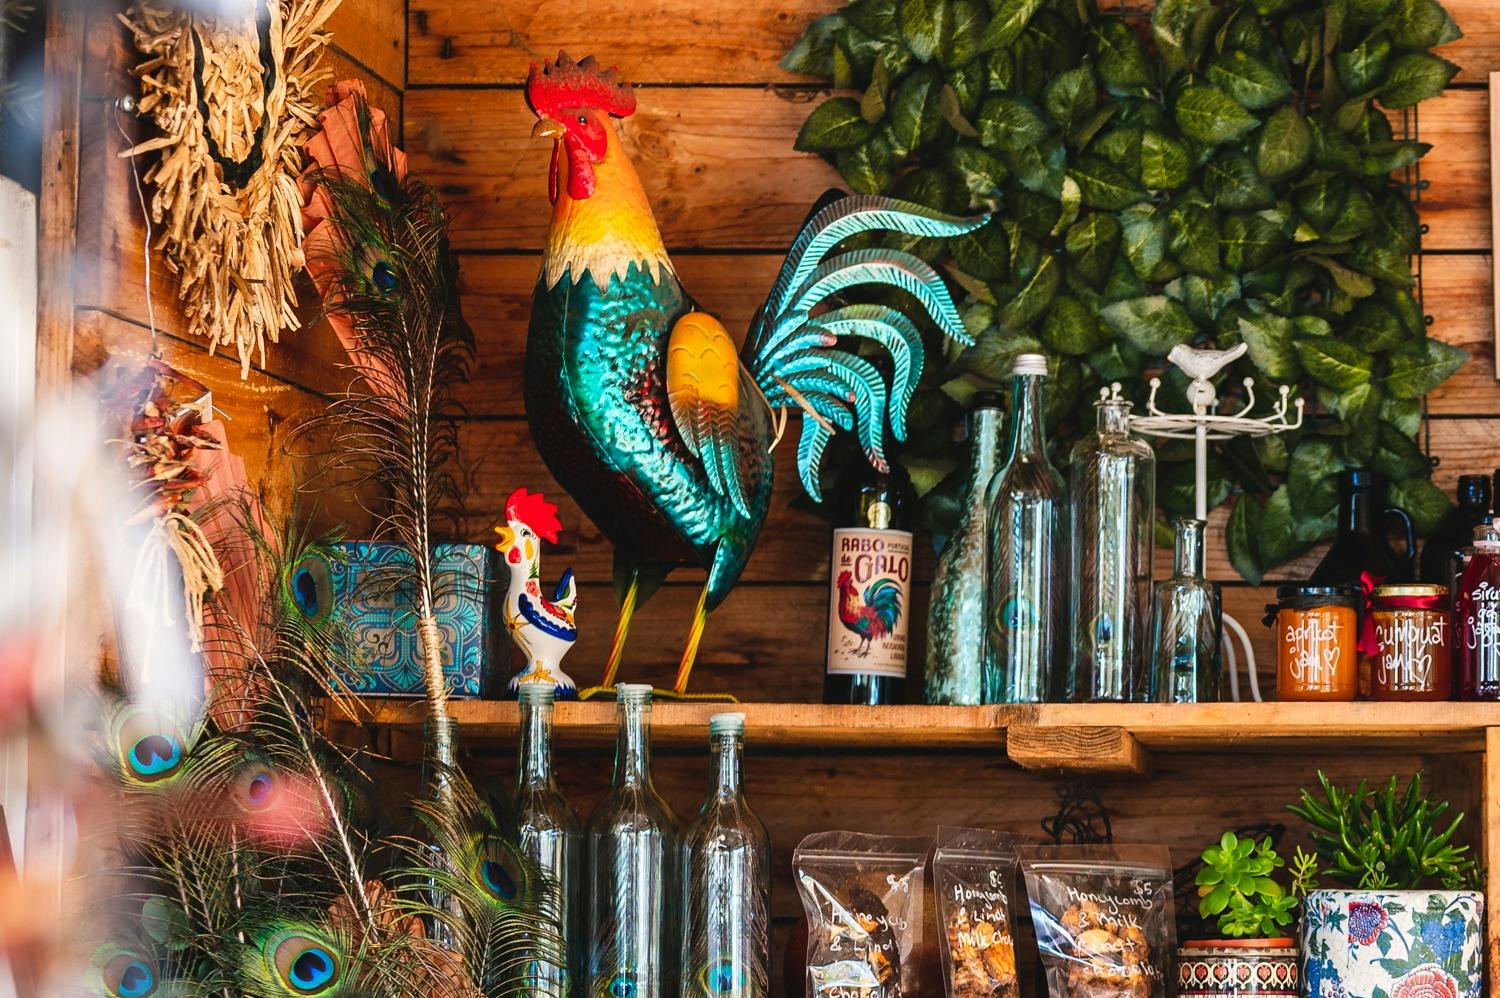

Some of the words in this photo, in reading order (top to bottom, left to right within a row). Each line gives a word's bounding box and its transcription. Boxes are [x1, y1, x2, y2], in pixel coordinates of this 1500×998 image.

[841, 538, 885, 552] RABO
[854, 553, 909, 584] GALO
[1131, 879, 1154, 896] $5
[1066, 886, 1153, 916] Honeycomb
[830, 935, 842, 952] &
